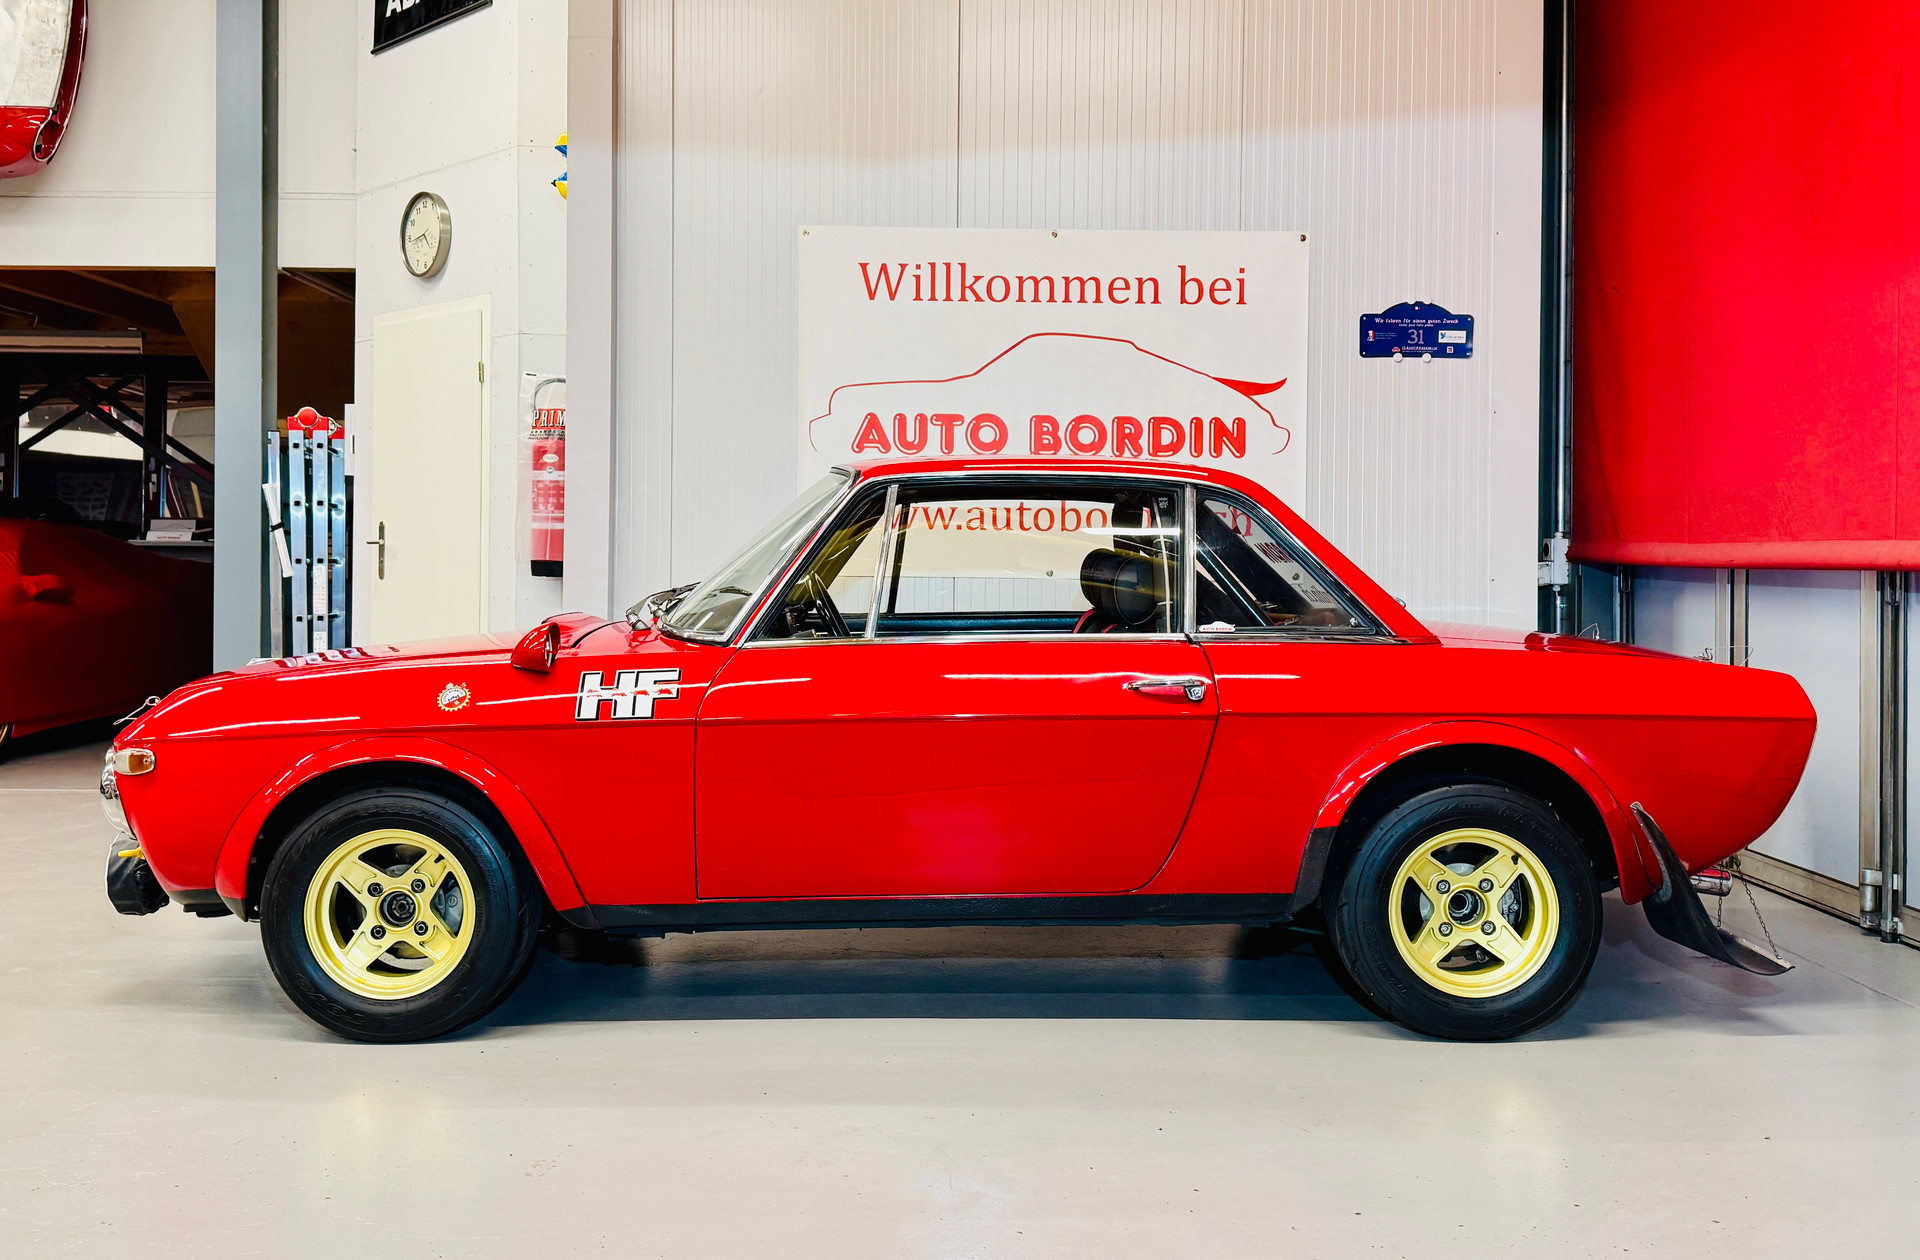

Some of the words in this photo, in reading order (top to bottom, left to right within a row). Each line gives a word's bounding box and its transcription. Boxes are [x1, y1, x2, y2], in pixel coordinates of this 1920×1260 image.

[857, 261, 1162, 304] Willkommen
[1178, 264, 1248, 306] bei
[1407, 329, 1425, 345] 31
[850, 412, 1009, 456] AUTO
[1028, 414, 1247, 459] BORDIN
[574, 667, 682, 721] HF
